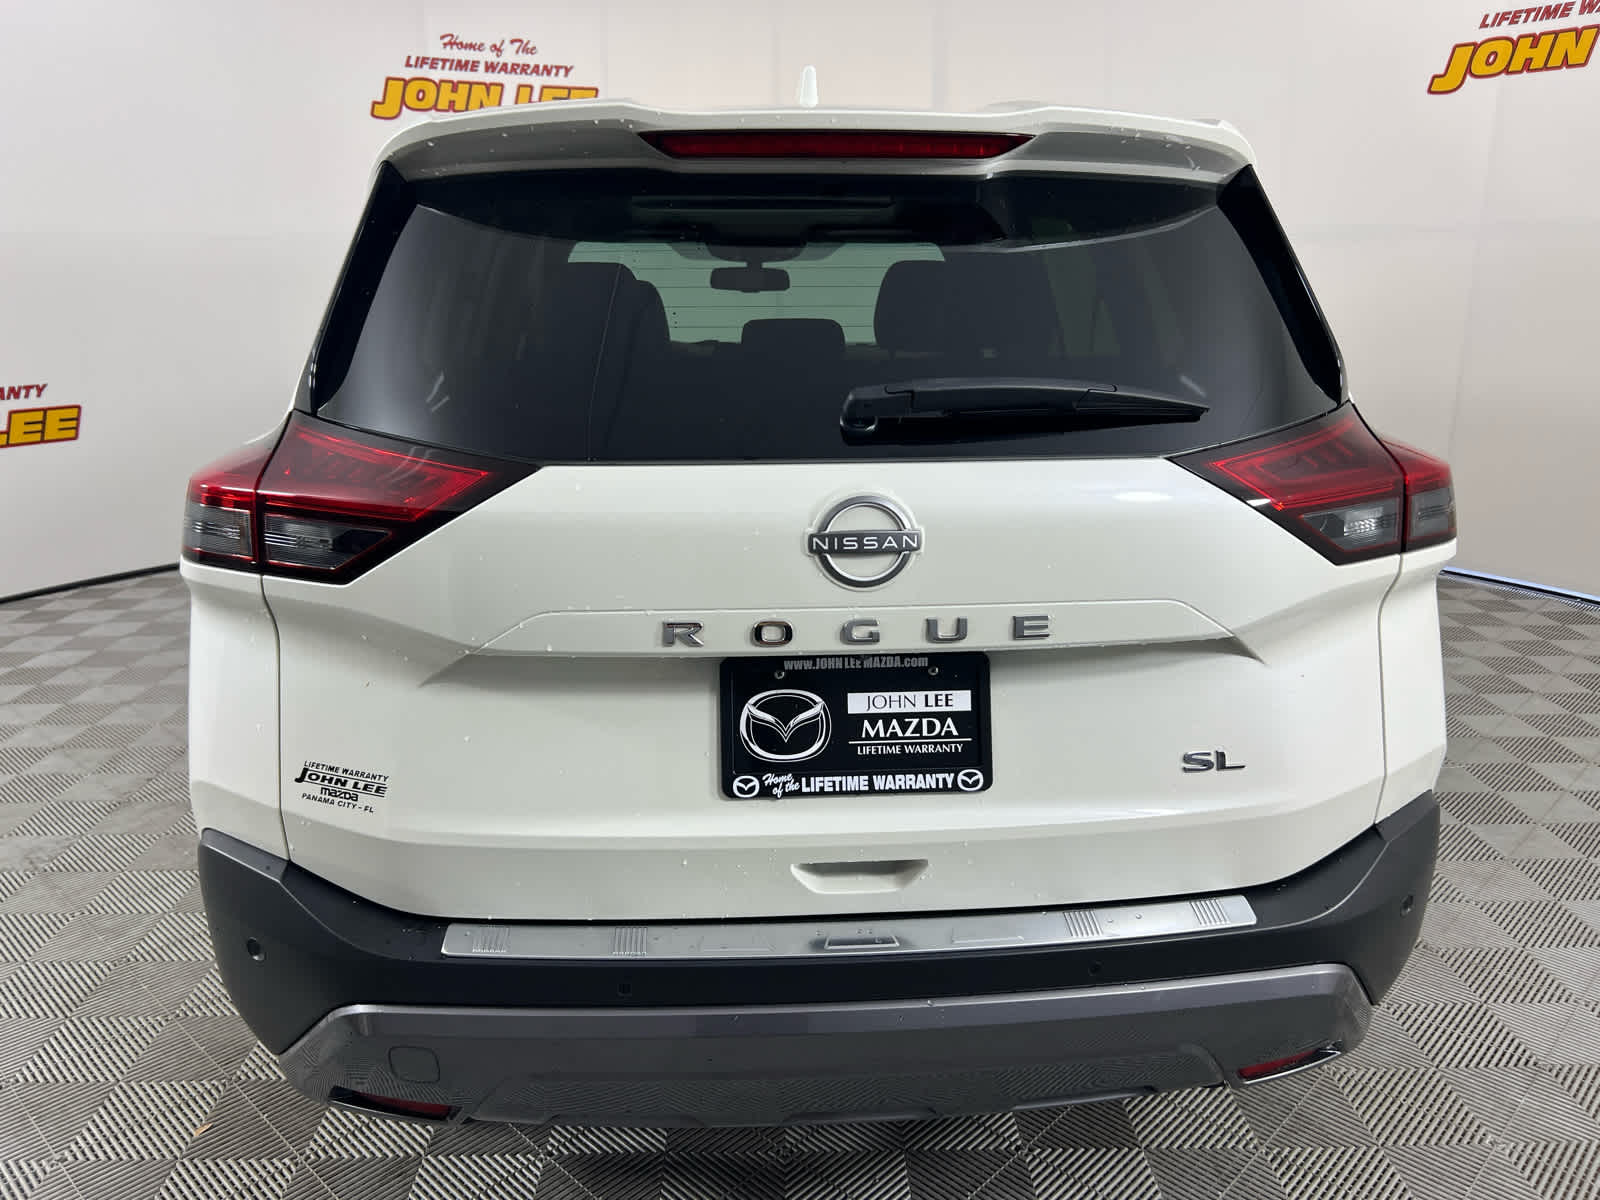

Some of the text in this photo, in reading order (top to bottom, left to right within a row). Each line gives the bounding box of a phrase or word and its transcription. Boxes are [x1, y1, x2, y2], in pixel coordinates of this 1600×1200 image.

[1479, 0, 1600, 29] LIFETIME W
[440, 33, 537, 57] Home of The
[404, 55, 574, 77] LIFETIME WARRANTY
[1427, 24, 1600, 95] JOHN
[371, 77, 504, 120] JOHN
[813, 535, 918, 550] NISSAN
[661, 615, 1051, 648] ROGUE
[866, 693, 954, 711] JOHN LEE
[861, 717, 959, 738] MAZDA
[857, 744, 963, 755] LIFETIME WARRANTY
[304, 760, 389, 782] LIFETIME WARRANTY
[1182, 750, 1246, 773] SL
[294, 767, 388, 795] JOHN LEE
[762, 773, 793, 787] Home
[772, 780, 801, 798] of the
[801, 773, 955, 793] LIFETIME WARRANTY
[301, 793, 335, 805] PANAMA
[337, 800, 357, 809] CITY
[363, 805, 375, 814] FL
